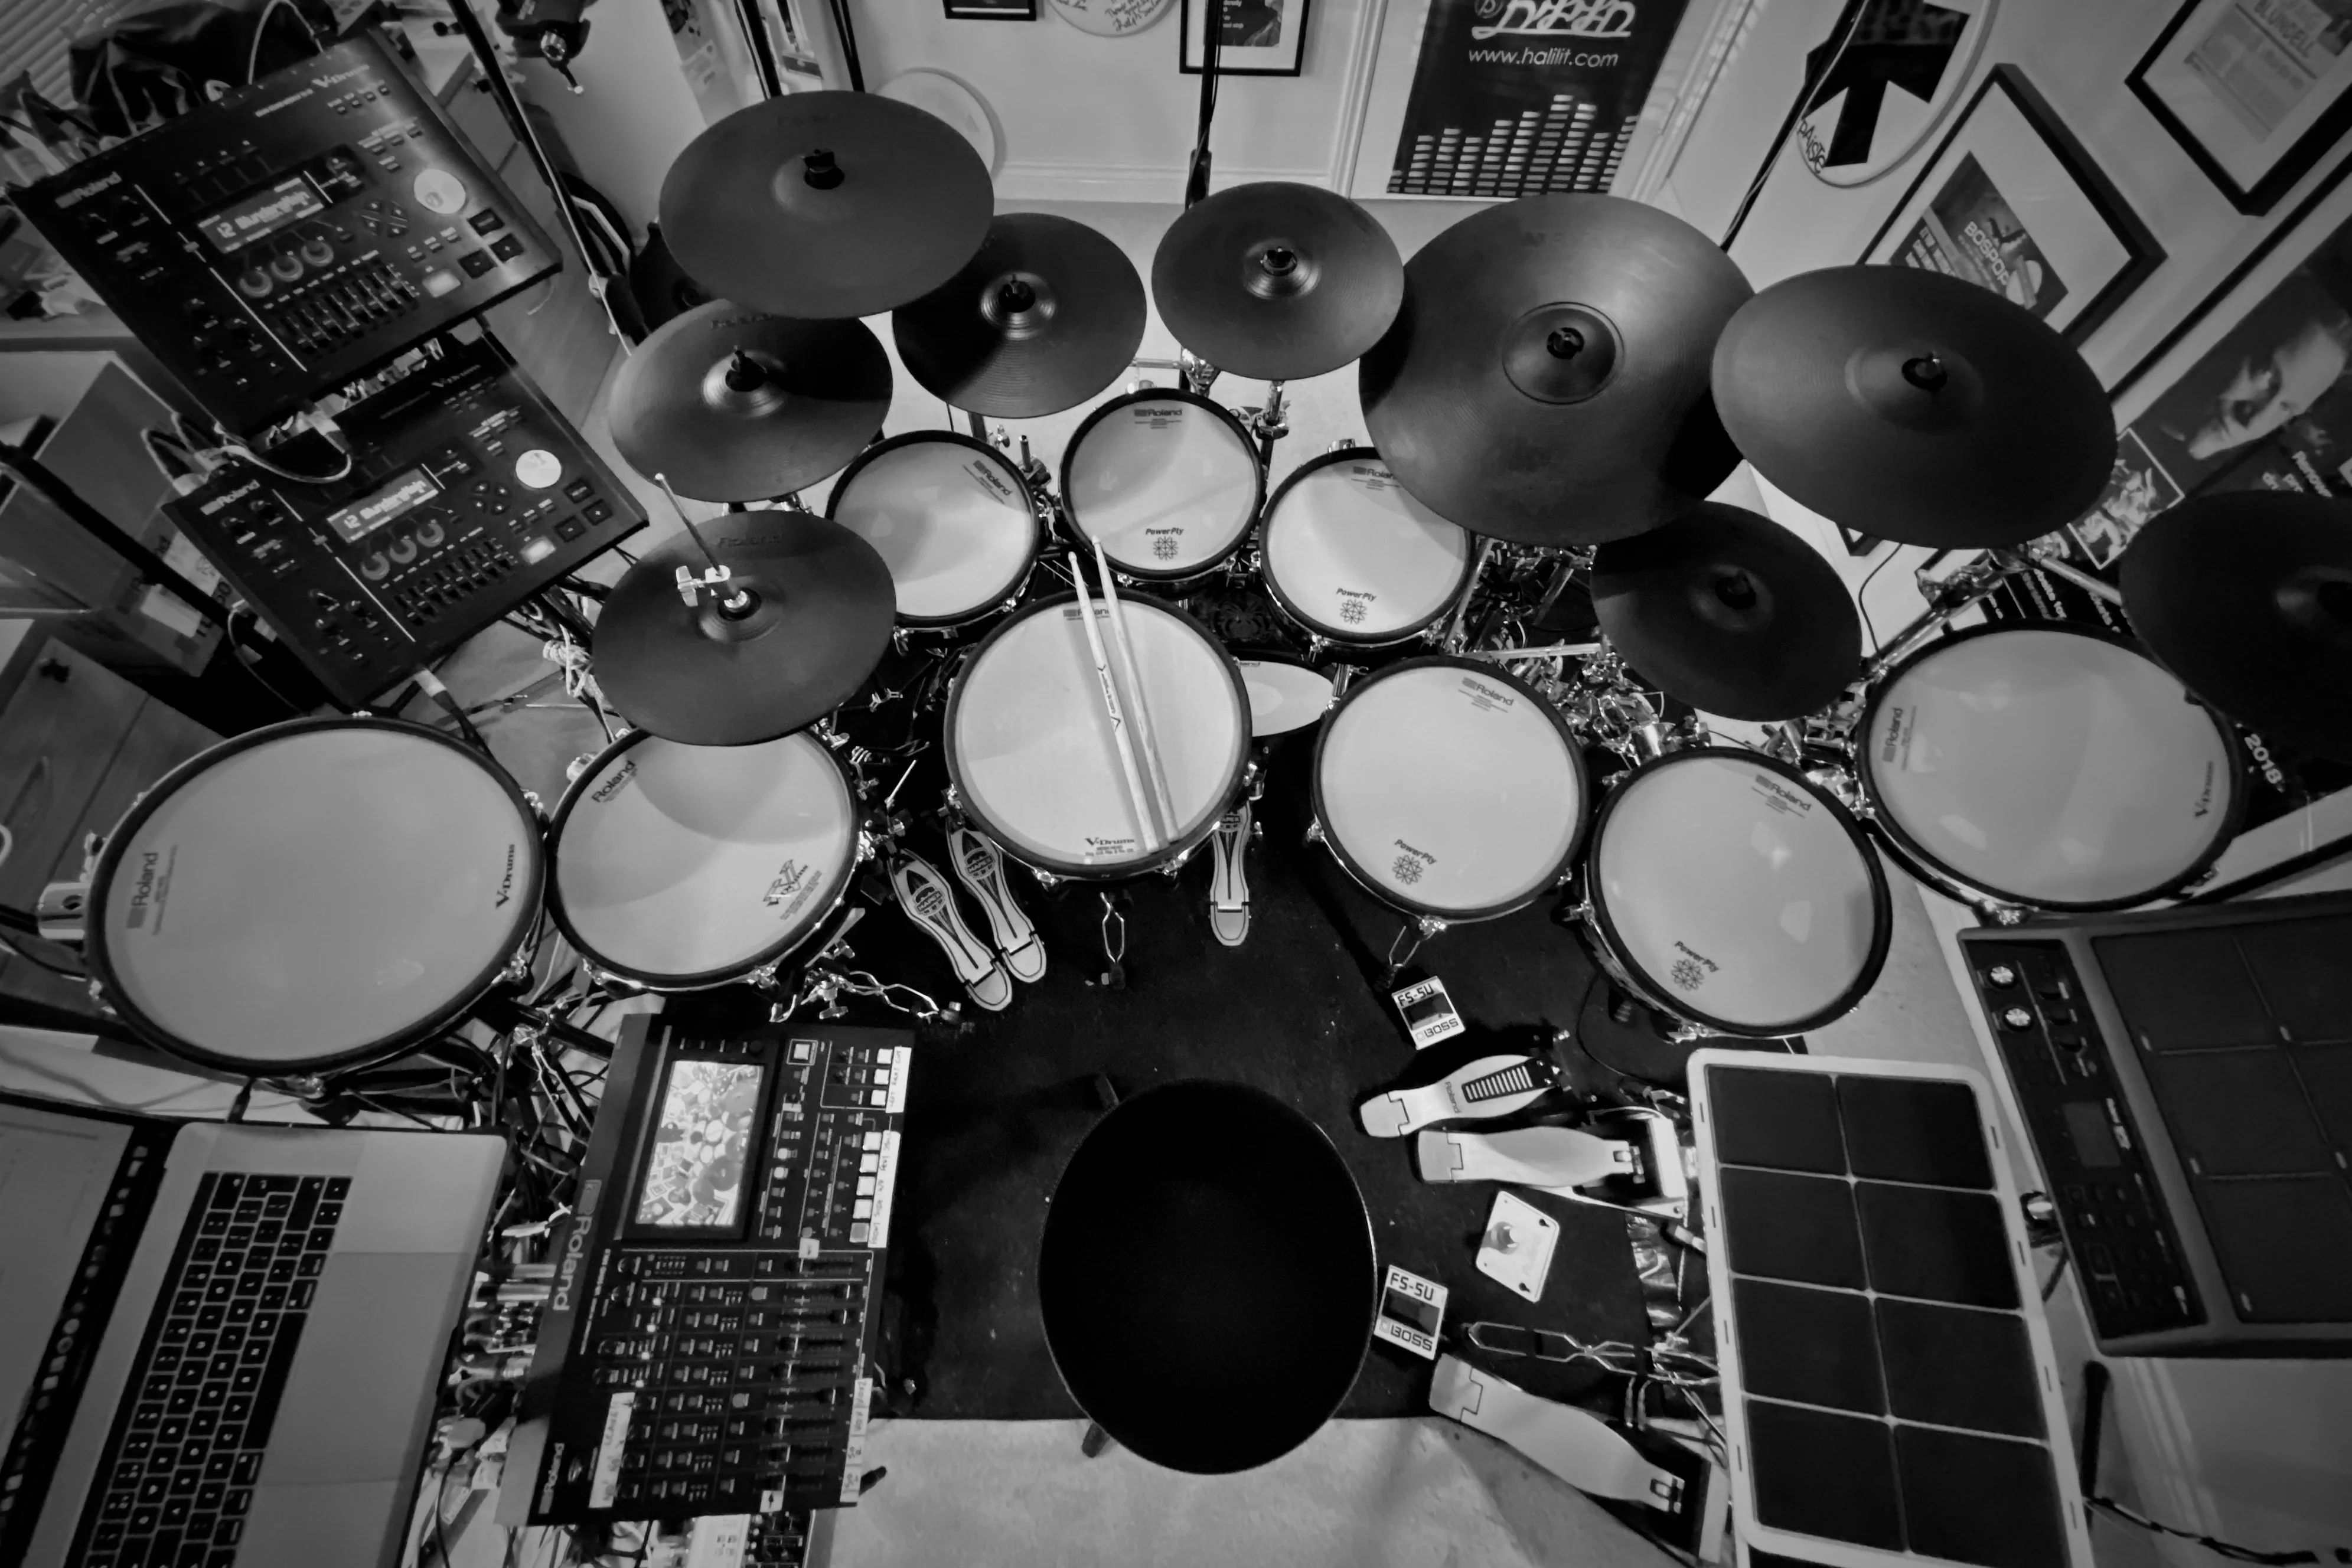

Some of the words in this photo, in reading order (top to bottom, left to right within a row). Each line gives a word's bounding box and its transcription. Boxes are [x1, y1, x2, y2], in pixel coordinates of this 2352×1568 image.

[1469, 47, 1619, 67] www.halilit.com
[1148, 409, 1183, 417] Roland
[984, 468, 1012, 496] Roland
[1146, 526, 1185, 537] PowerPly
[1336, 587, 1377, 604] PowerPly
[1476, 684, 1515, 706] Roland
[1887, 707, 1904, 749] Roland
[2243, 730, 2284, 786] 2018
[592, 760, 637, 803] Roland
[2194, 760, 2215, 818] V-Drums
[1770, 781, 1813, 812] Roland
[1085, 837, 1134, 845] V-Drums
[1394, 838, 1438, 865] PowerPly
[130, 851, 160, 908] Roland
[494, 843, 517, 910] V-Drums
[1675, 940, 1721, 972] PowerPly
[1397, 984, 1434, 1006] FS-5U
[1423, 1018, 1459, 1037] BOSS
[1444, 1082, 1462, 1113] Roland
[552, 1214, 592, 1313] Roland
[1389, 1272, 1434, 1301] FS-5U
[1390, 1324, 1433, 1351] BOSS
